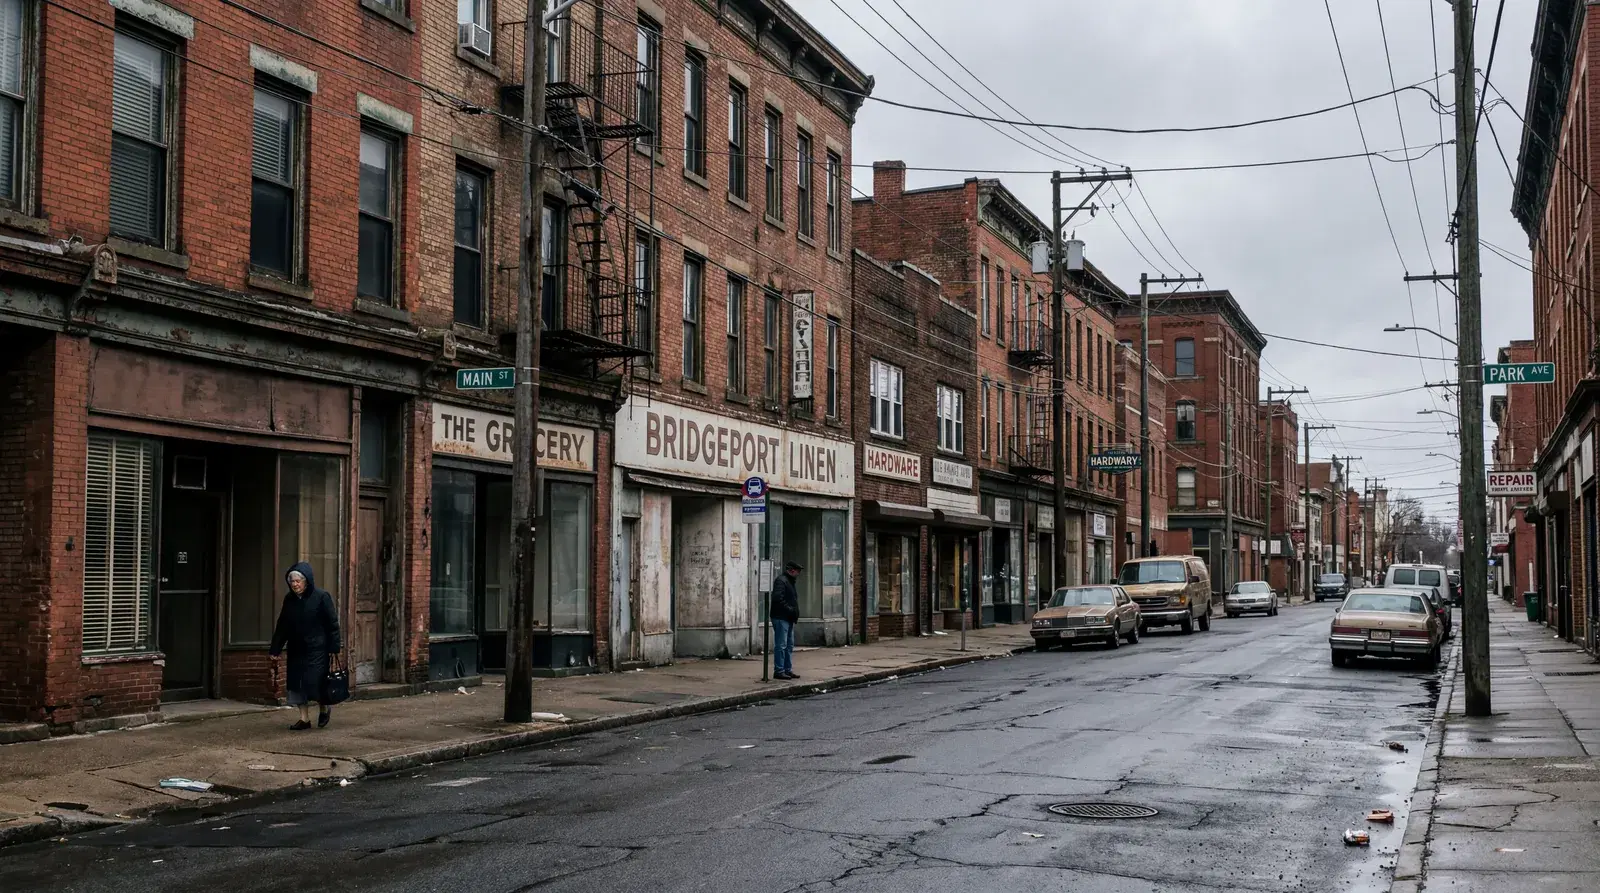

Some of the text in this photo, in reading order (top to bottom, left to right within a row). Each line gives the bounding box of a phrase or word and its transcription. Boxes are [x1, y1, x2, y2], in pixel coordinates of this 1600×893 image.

[462, 371, 509, 386] MAIN ST
[1490, 366, 1550, 381] PARK AVE
[441, 413, 585, 461] THE GRCERY
[646, 411, 836, 483] BRIDGEPORT LINEN
[867, 449, 919, 477] HARDWARE
[1090, 456, 1139, 467] HARDWARY
[1489, 475, 1534, 486] REPAIR
